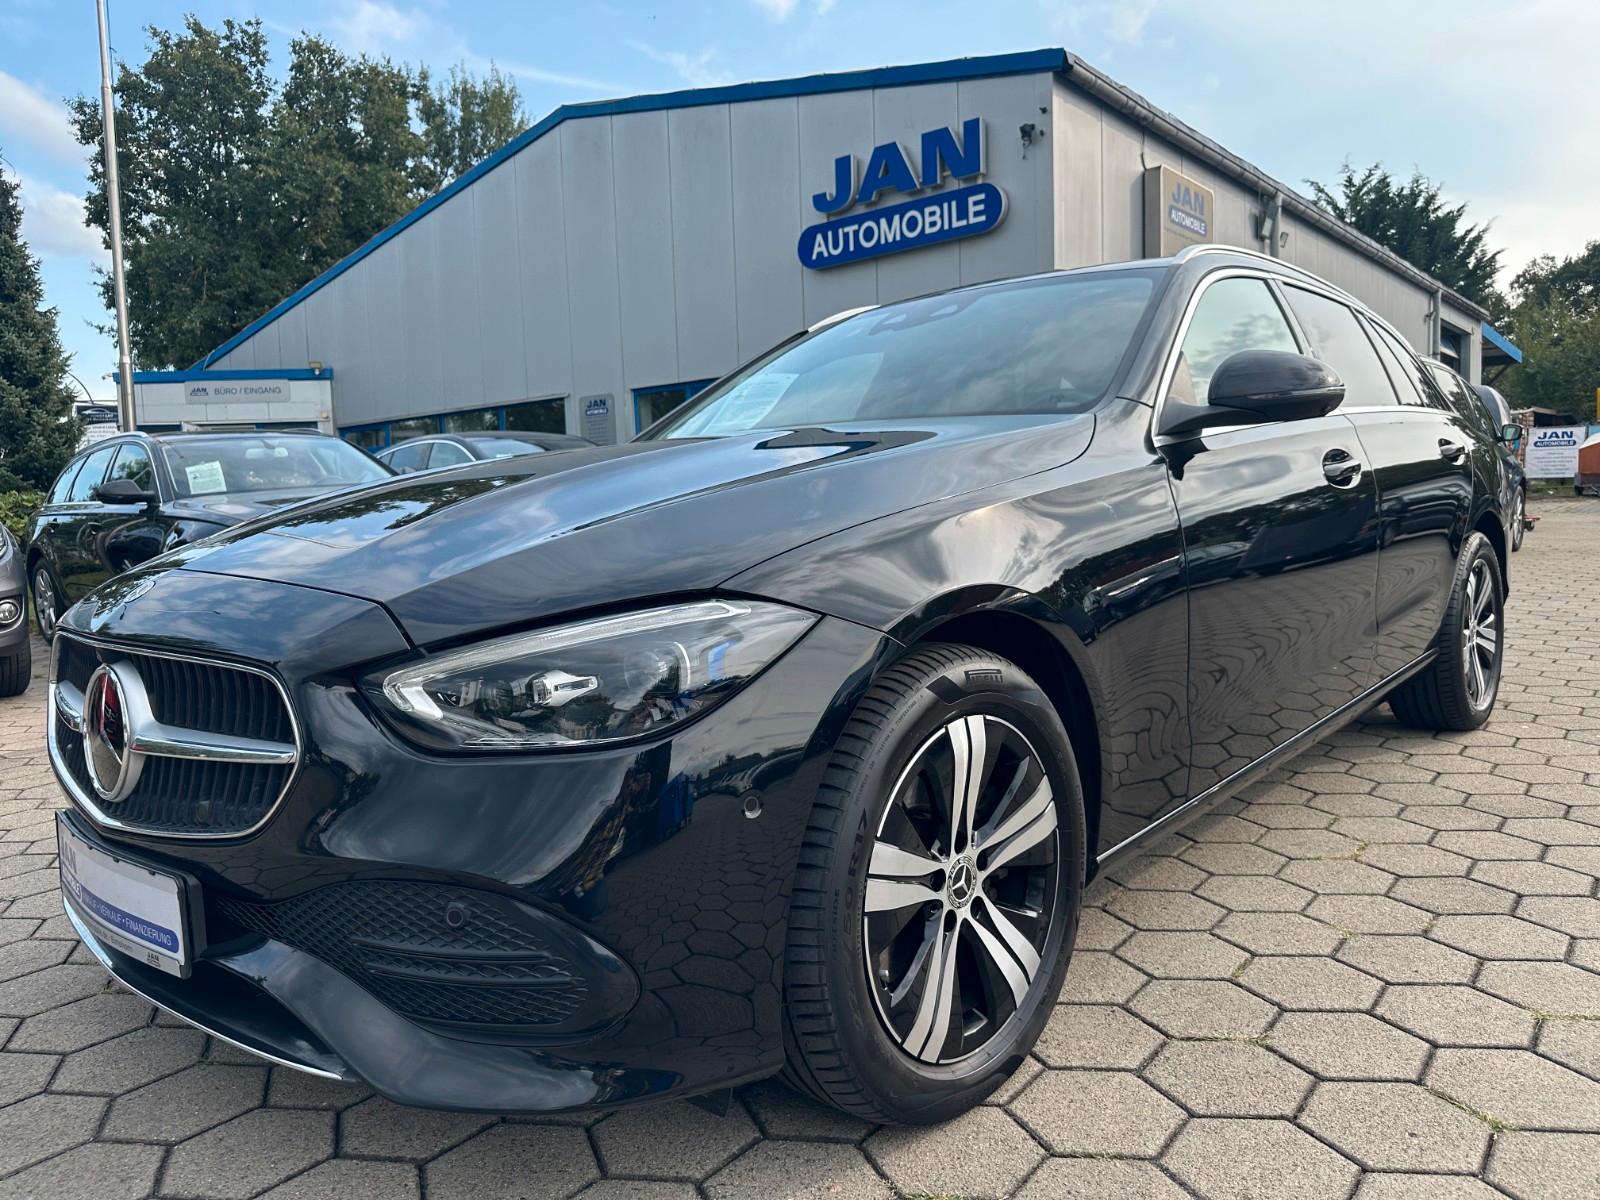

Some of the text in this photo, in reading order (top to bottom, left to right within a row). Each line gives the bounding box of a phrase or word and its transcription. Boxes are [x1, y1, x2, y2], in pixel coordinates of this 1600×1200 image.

[812, 116, 984, 213] JAN
[1172, 182, 1204, 215] JAN
[811, 193, 986, 260] AUTOMOBILE
[1171, 207, 1206, 235] AUTOMOBILE
[214, 386, 237, 396] BÜRO
[244, 386, 282, 395] EINGANG
[587, 399, 606, 408] JAN
[1537, 431, 1573, 439] JAN
[125, 917, 172, 946] FINANZIERUNG
